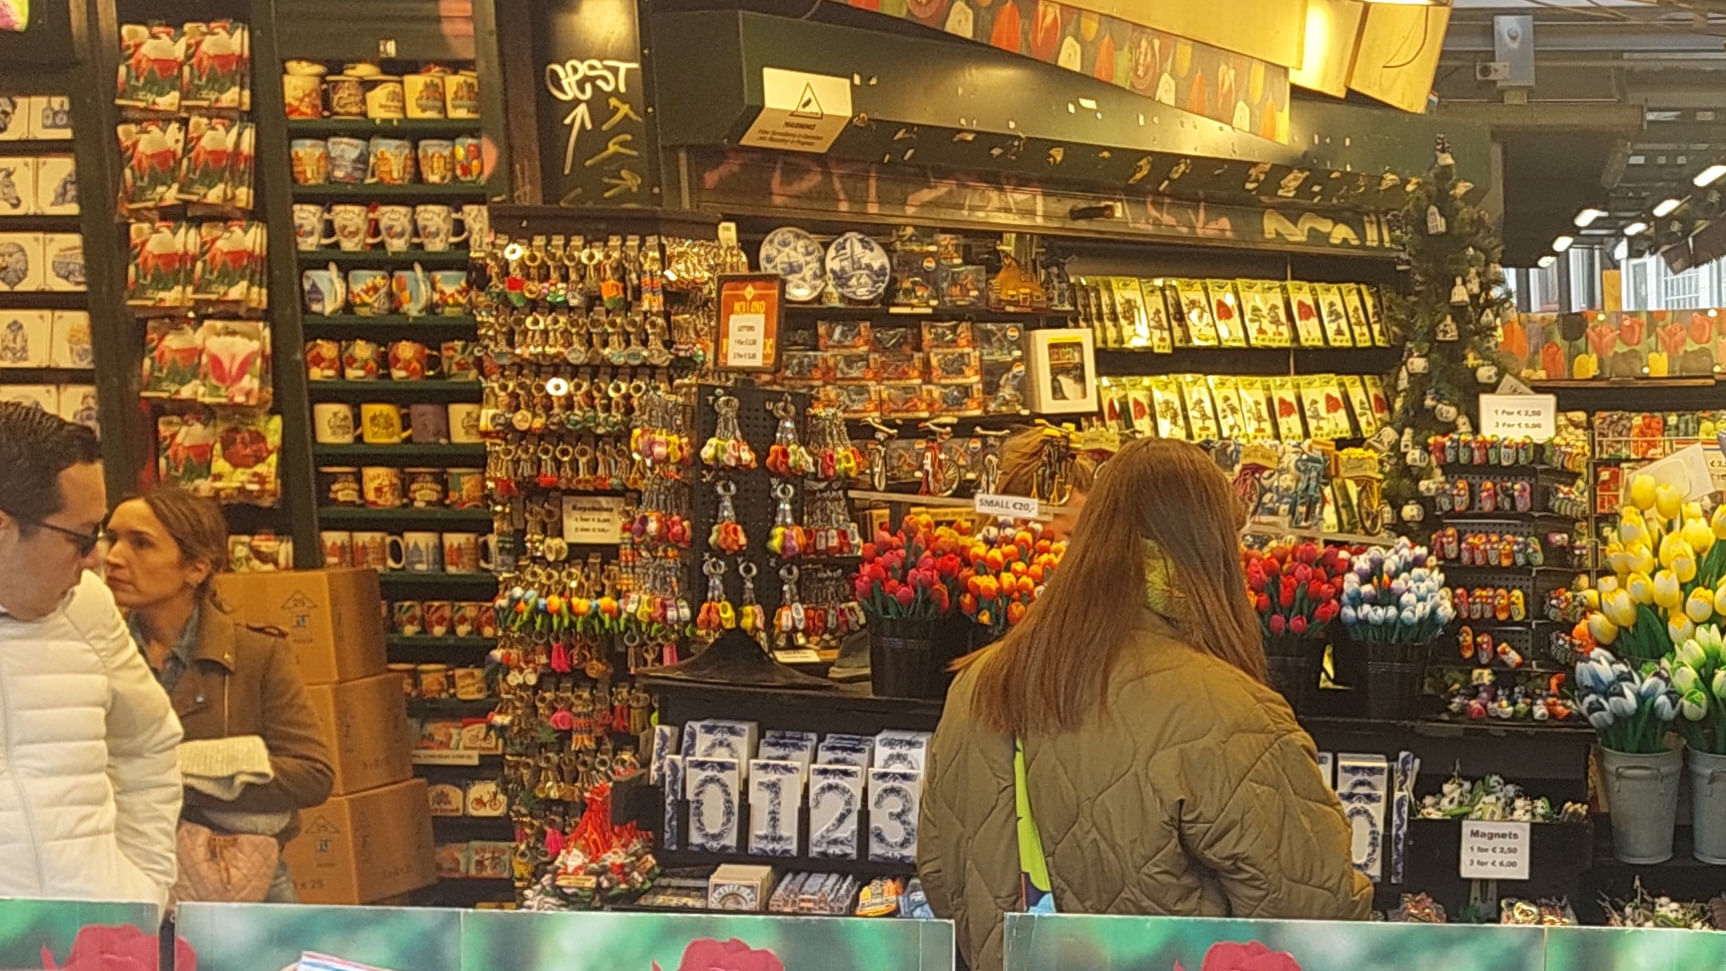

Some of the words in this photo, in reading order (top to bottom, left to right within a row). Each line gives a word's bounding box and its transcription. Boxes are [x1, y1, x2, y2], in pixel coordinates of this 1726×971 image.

[979, 498, 1011, 510] SMALL
[691, 774, 735, 841] 0
[755, 777, 794, 843] 1
[811, 780, 856, 848] 2
[872, 783, 916, 849] 3
[1469, 830, 1520, 842] Magnets
[1477, 860, 1489, 868] for
